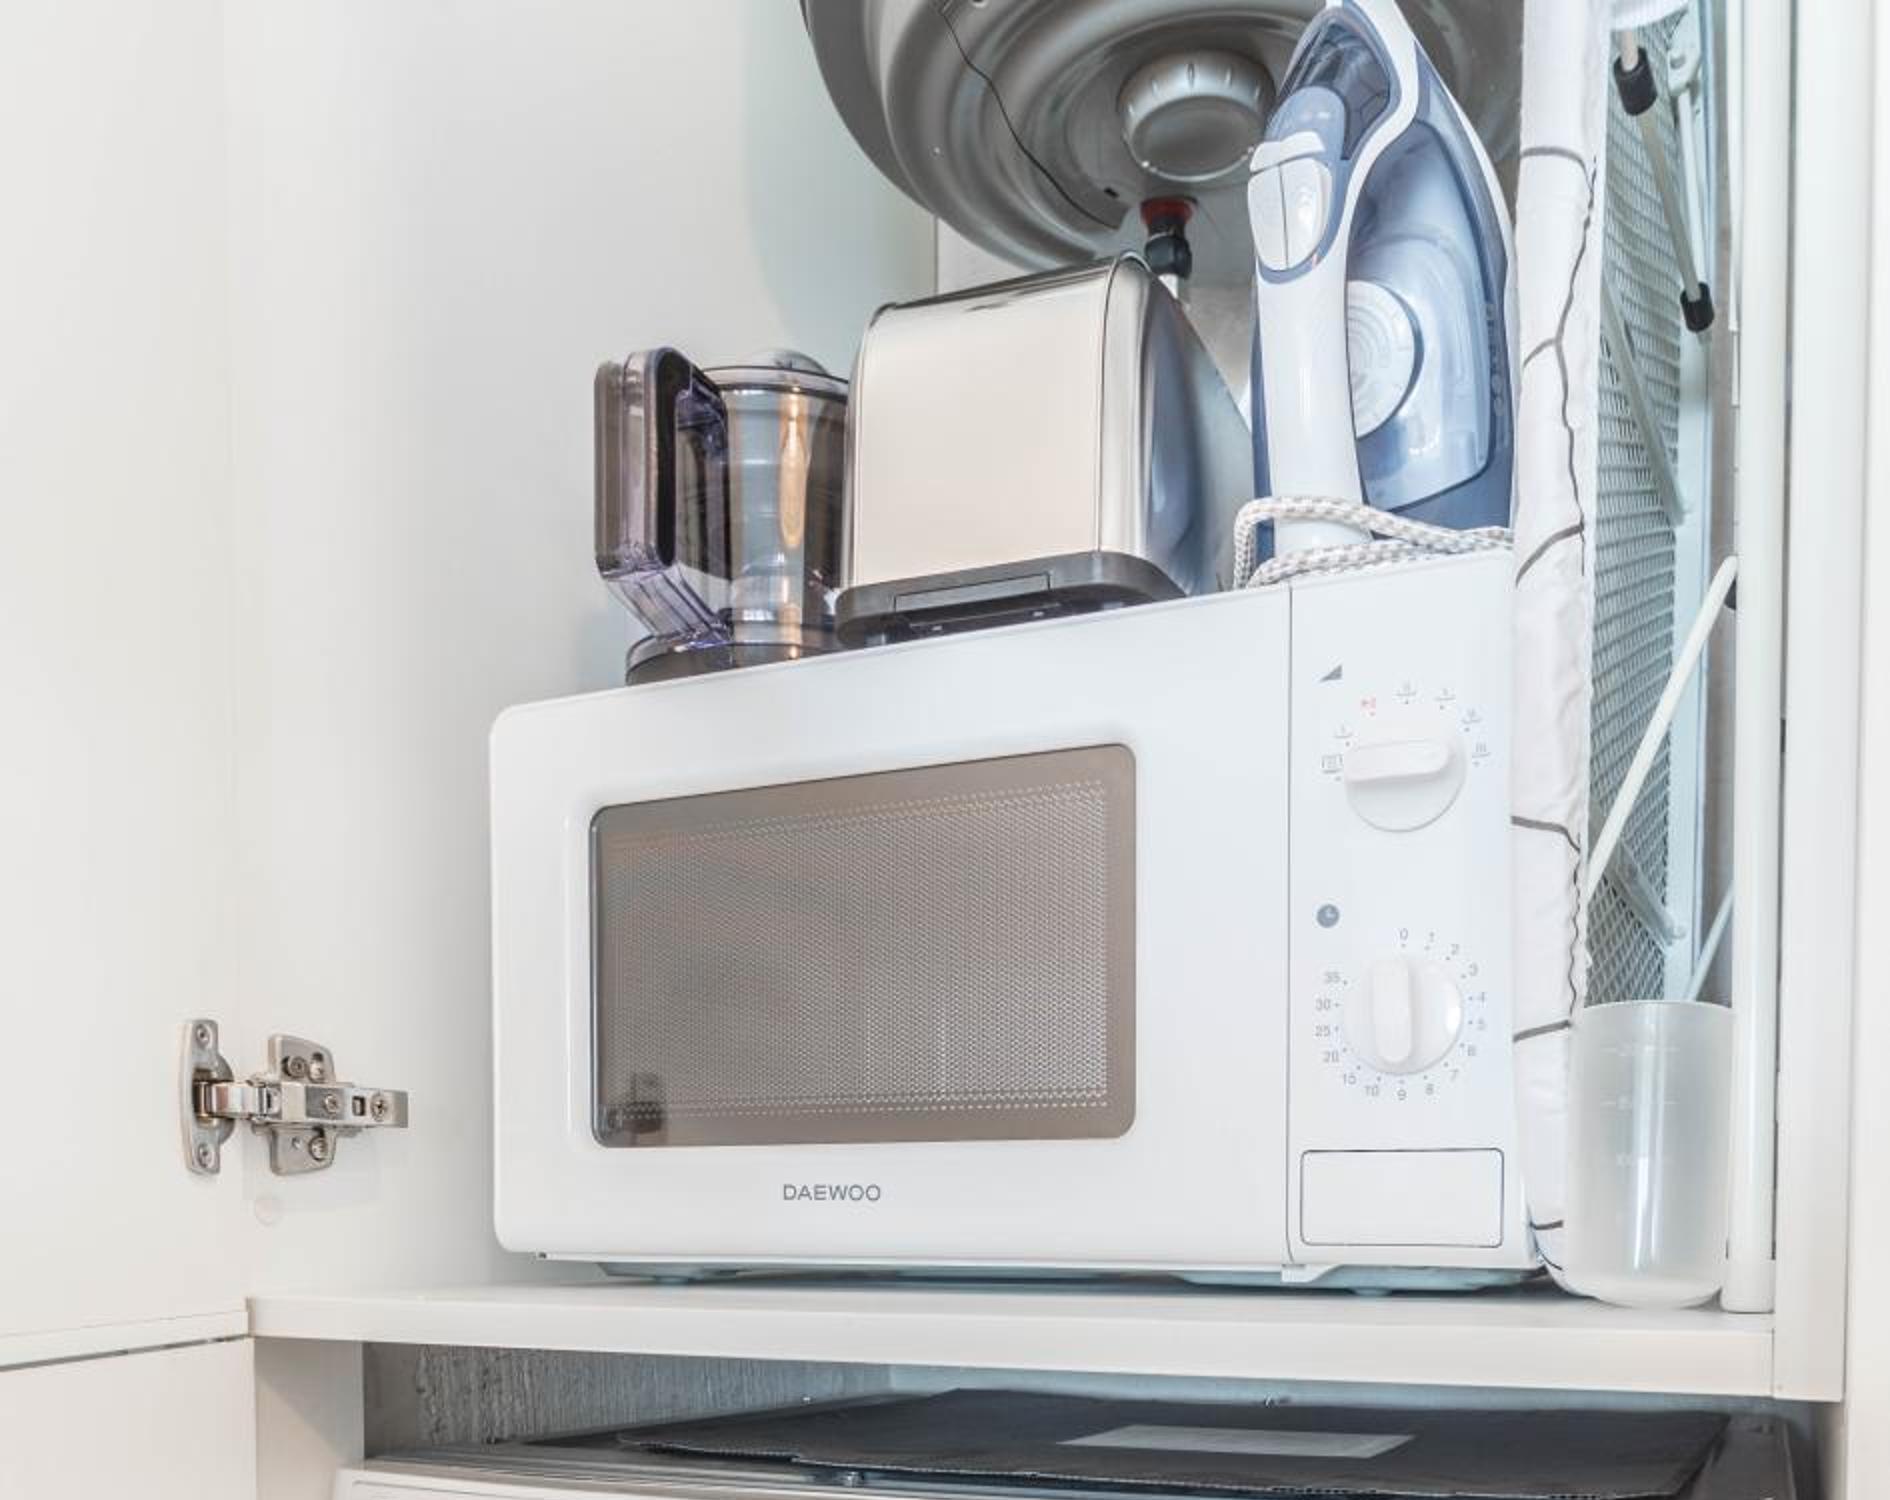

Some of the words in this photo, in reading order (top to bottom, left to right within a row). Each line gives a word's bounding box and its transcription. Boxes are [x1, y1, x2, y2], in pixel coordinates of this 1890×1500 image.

[1315, 998, 1331, 1011] 30
[1322, 1050, 1340, 1063] 20
[783, 1183, 882, 1202] DAEWOO
